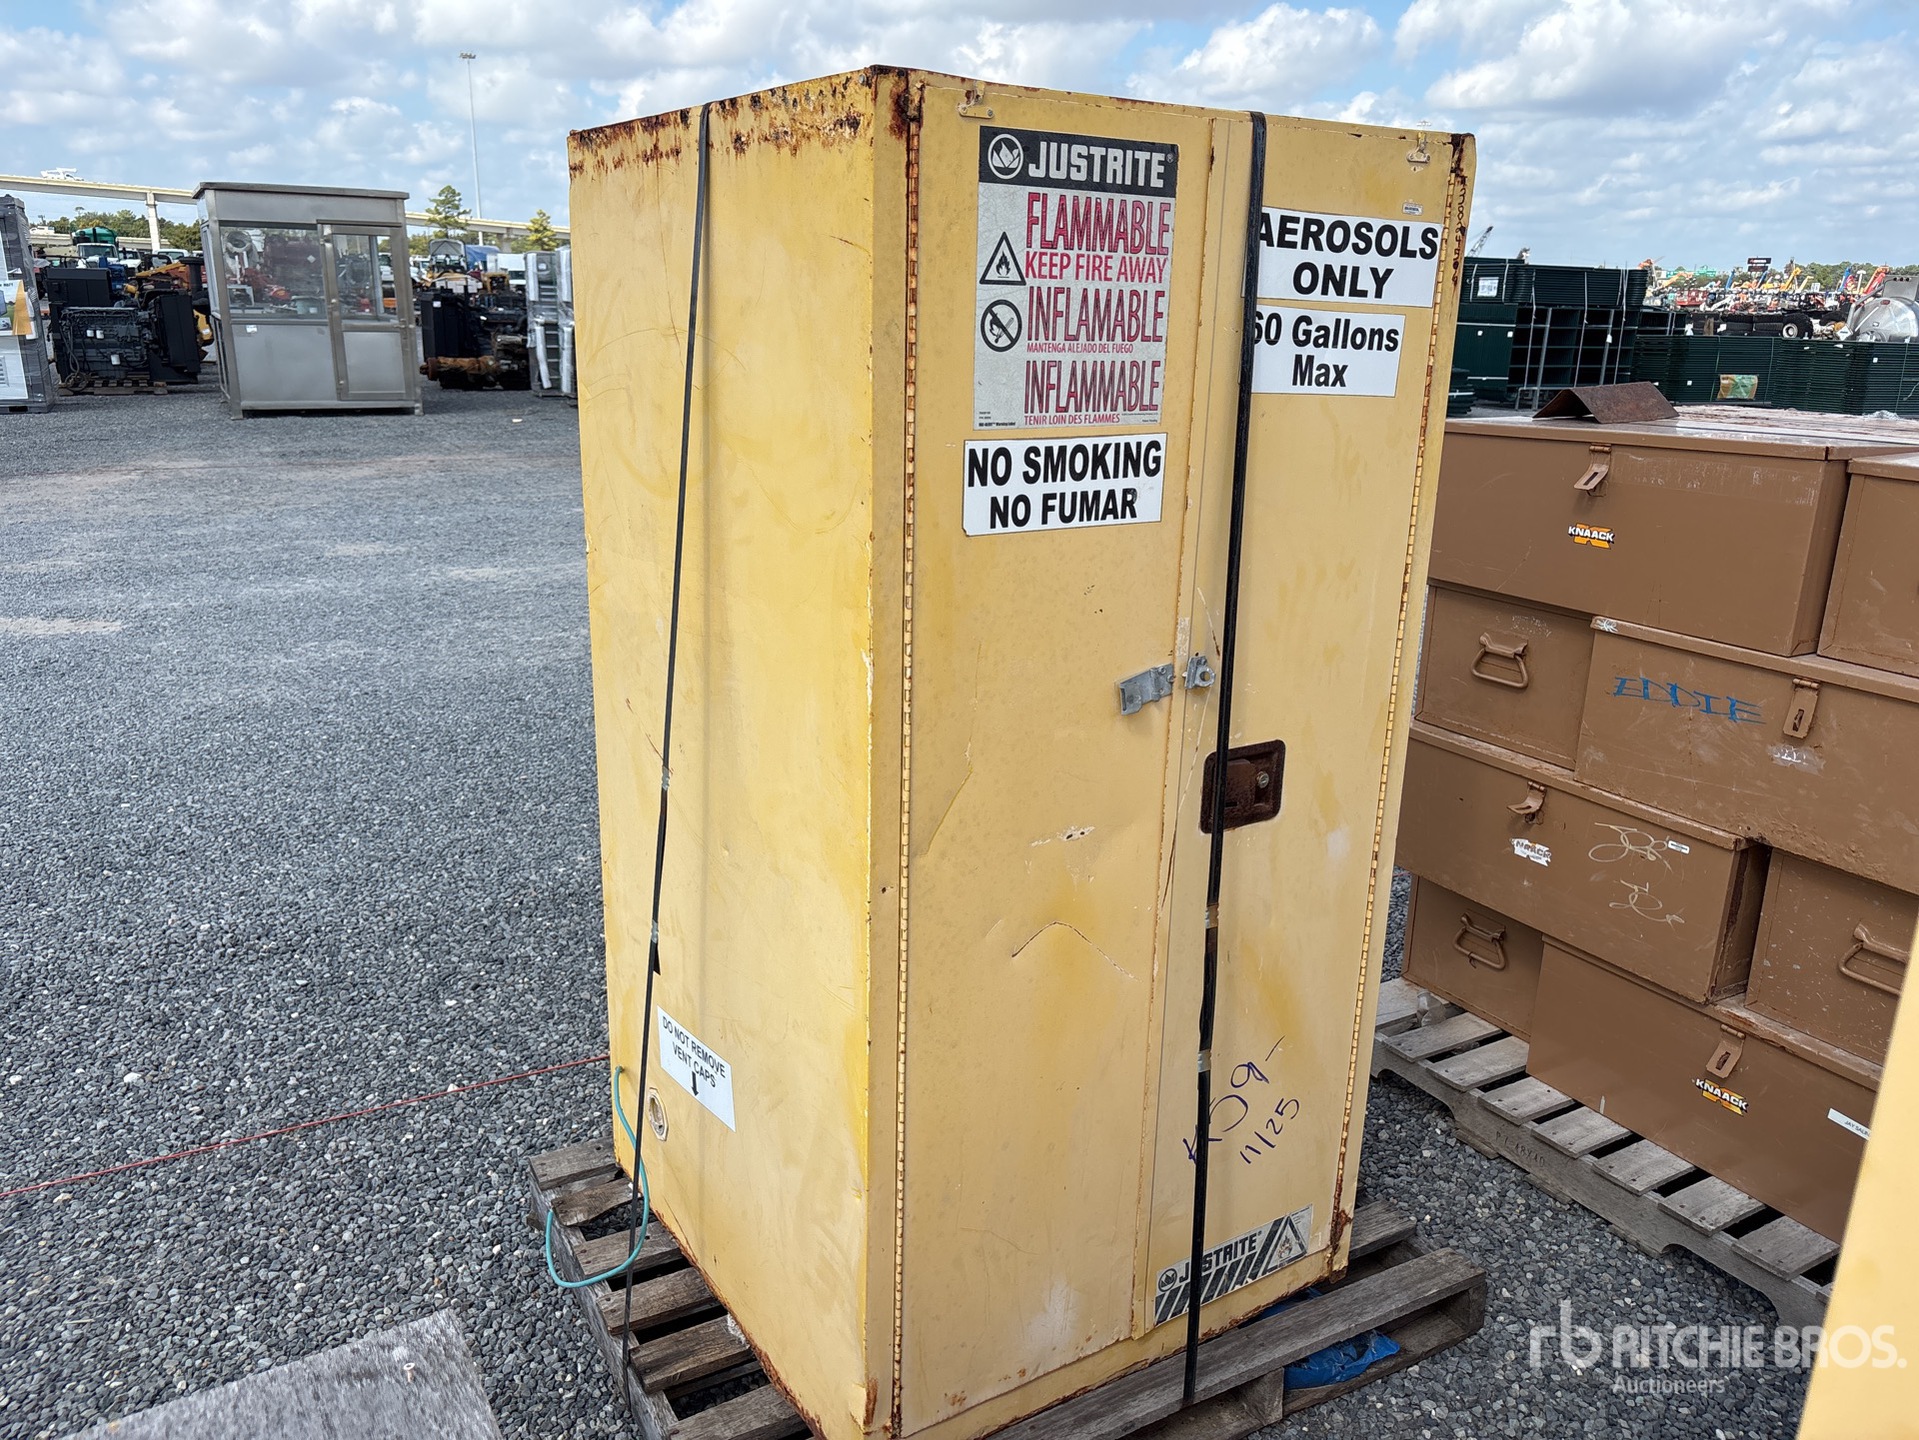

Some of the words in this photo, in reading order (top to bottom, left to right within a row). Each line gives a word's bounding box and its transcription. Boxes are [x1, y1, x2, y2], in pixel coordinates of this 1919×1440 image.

[1028, 141, 1166, 188] JUSTRITE
[1026, 192, 1171, 255] FLAMMABLE
[1259, 212, 1440, 260] AEROSOLS
[1025, 251, 1072, 280] KEEP
[1075, 253, 1113, 282] FIRE
[1116, 255, 1168, 284] AWAY
[1293, 262, 1394, 299] ONLY
[1027, 286, 1166, 342] INFLAMABLE
[1292, 315, 1399, 352] Gallons
[1027, 342, 1066, 353] MANTENGA
[1068, 343, 1097, 354] ALEJADO
[1098, 343, 1110, 354] DEL
[1112, 343, 1134, 354] FUEGO
[1024, 360, 1162, 414] INFLAMMABLE
[1292, 354, 1349, 388] Max
[1024, 415, 1047, 426] TENIR
[1048, 414, 1067, 425] LOIN
[1068, 414, 1083, 425] DES
[1084, 413, 1120, 424] FLAMMES
[968, 447, 1012, 488] NO
[1022, 440, 1161, 484] SMOKING
[990, 494, 1031, 529] NO
[1041, 488, 1138, 525] FUMAR
[1568, 525, 1615, 542] KNAACK
[663, 1016, 674, 1034] DO
[674, 1027, 690, 1048] NOT
[691, 1040, 726, 1079] REMOVE
[672, 1041, 692, 1068] VENT
[693, 1061, 716, 1088] CAPS
[1695, 1078, 1749, 1111] KNAACK
[1179, 1233, 1257, 1283] JSTRITE
